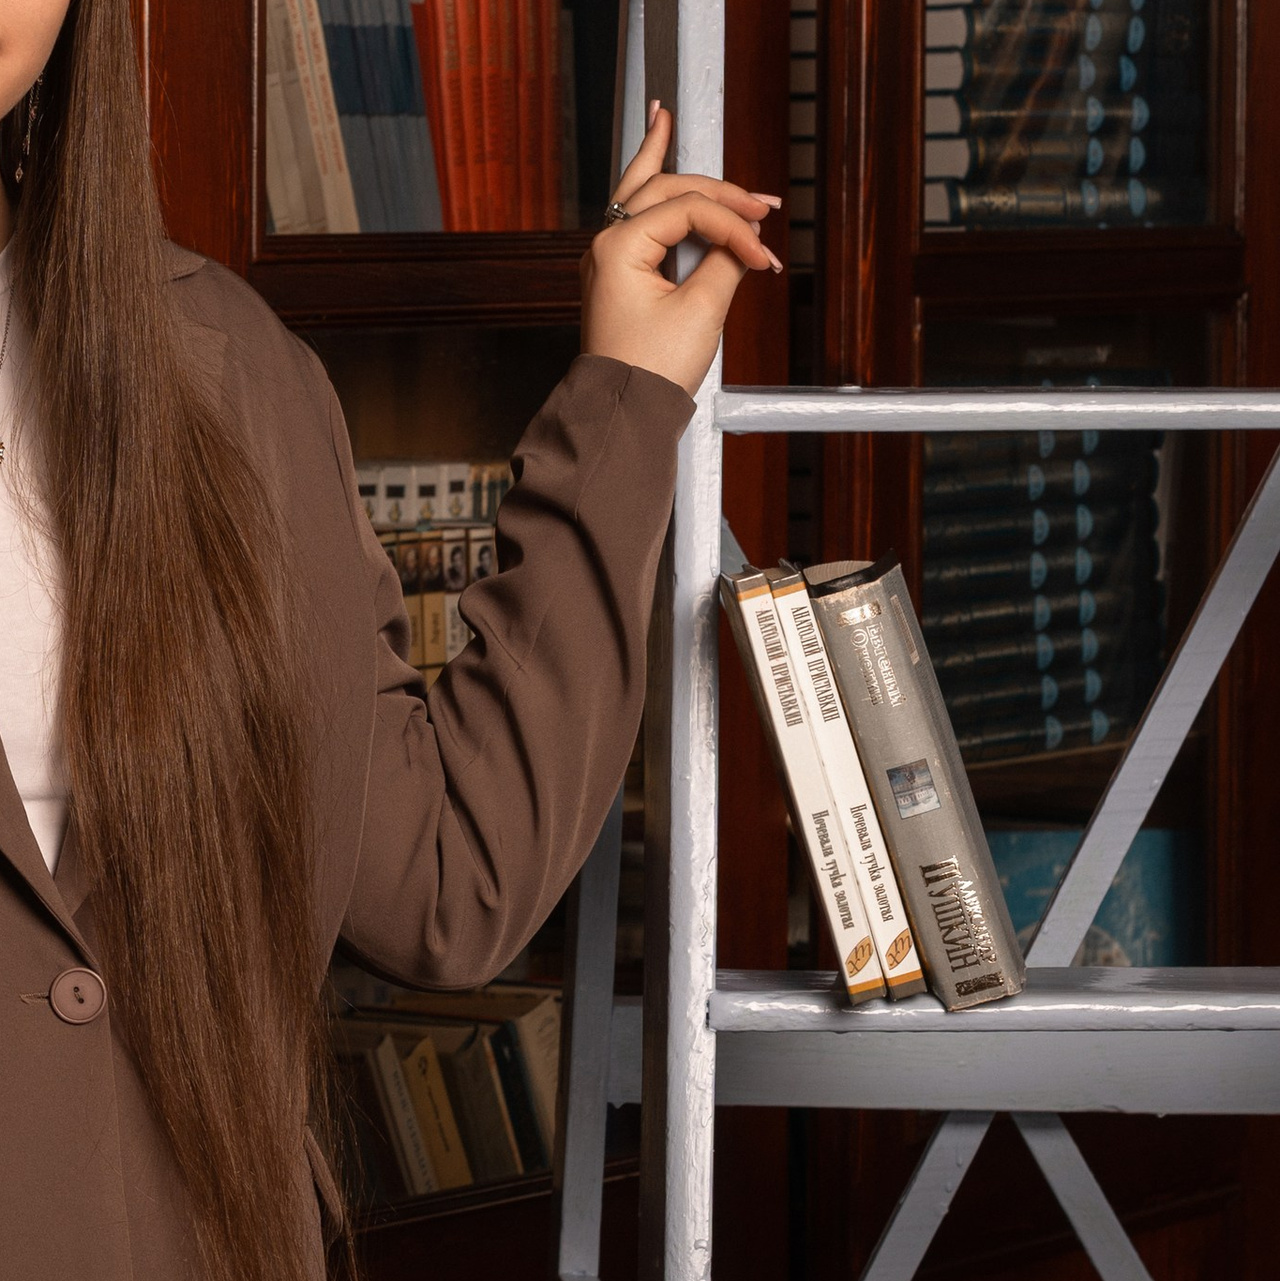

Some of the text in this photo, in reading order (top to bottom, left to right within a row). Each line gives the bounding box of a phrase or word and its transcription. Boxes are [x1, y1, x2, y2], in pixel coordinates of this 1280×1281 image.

[757, 610, 856, 930] АНАТОЛИЙ ПРИСТАВКИН Ночевала тучка золотая
[790, 605, 894, 922] АНАТОЛИЙ ПРИСТАВКИН Ночевала тучка золотая
[918, 855, 981, 973] ПУШКИН
